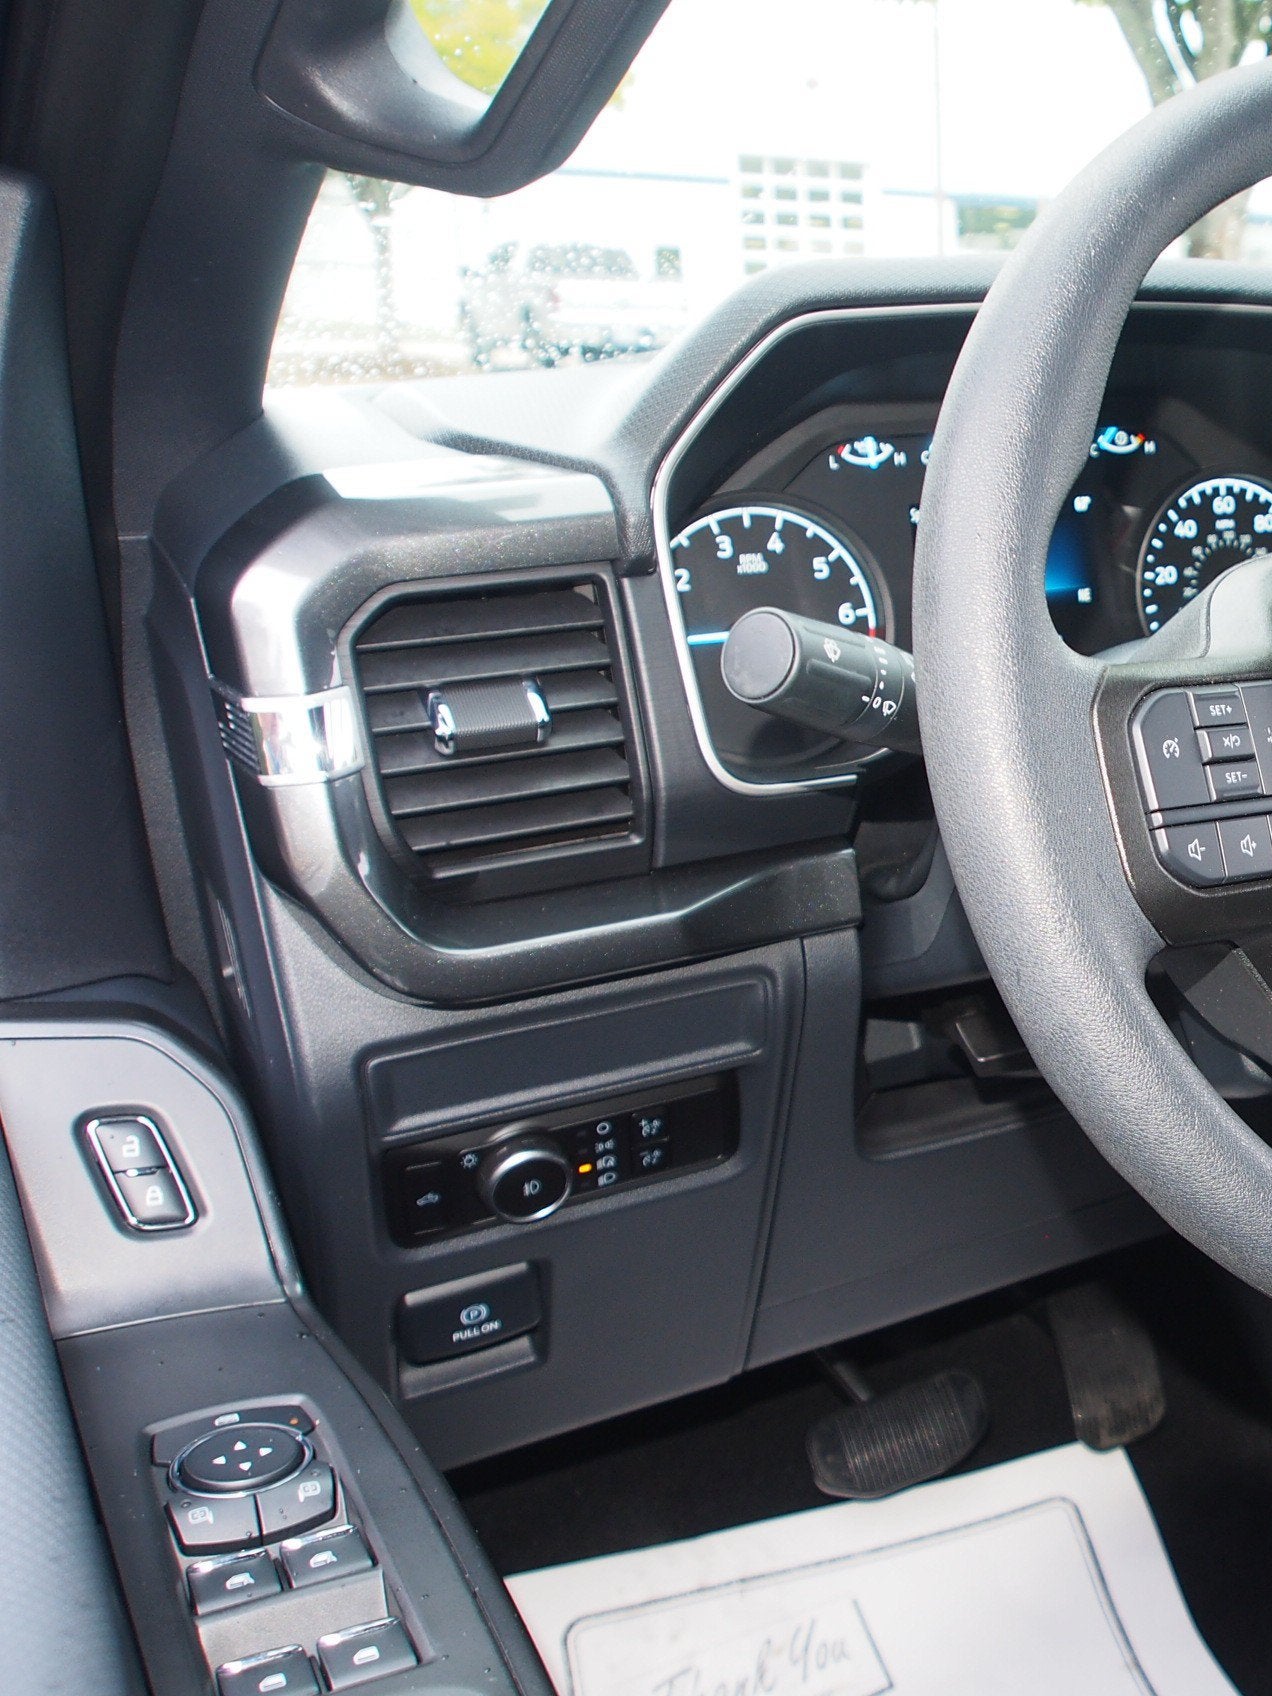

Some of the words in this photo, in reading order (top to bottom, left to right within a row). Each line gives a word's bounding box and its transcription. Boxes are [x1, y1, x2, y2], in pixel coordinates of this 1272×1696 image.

[1212, 495, 1236, 516] 60
[1174, 518, 1198, 539] 40
[715, 535, 734, 559] 3
[766, 531, 785, 555] 4
[674, 567, 692, 593] 2
[812, 556, 830, 580] 5
[1154, 565, 1179, 586] 20
[838, 602, 856, 625] 6
[452, 1326, 480, 1343] PULL
[481, 1319, 502, 1334] ON
[789, 1616, 850, 1684] You
